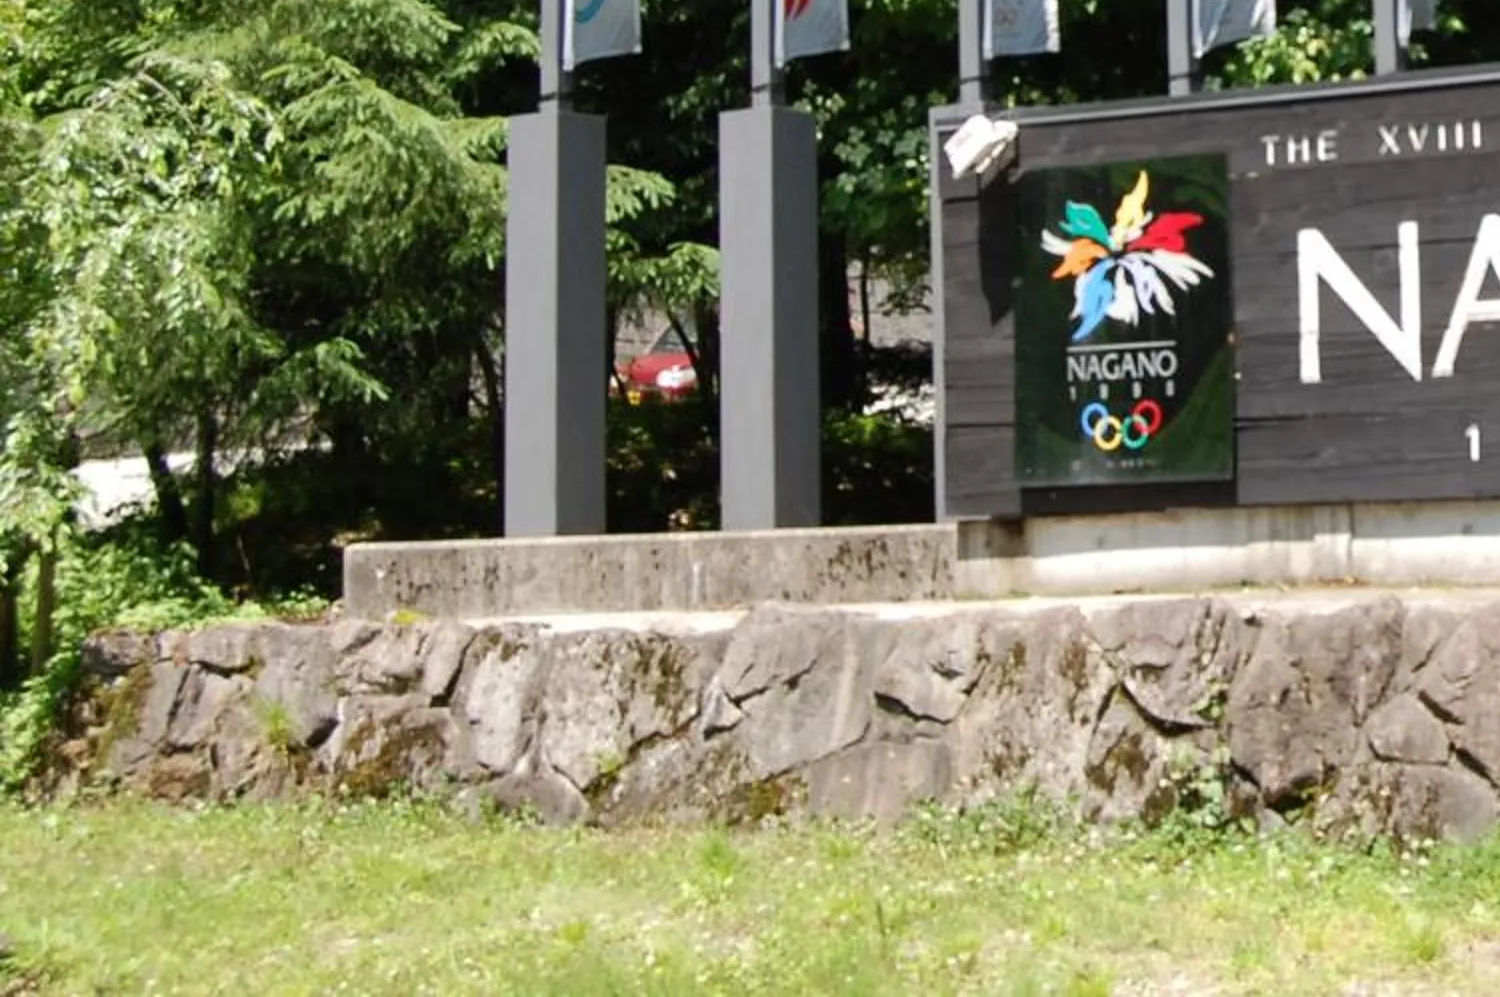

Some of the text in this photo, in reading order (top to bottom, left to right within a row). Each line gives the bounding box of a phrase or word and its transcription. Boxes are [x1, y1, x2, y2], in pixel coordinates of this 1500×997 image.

[1259, 130, 1340, 166] THE
[1378, 120, 1483, 156] XVIII
[1065, 349, 1179, 383] NAGANO
